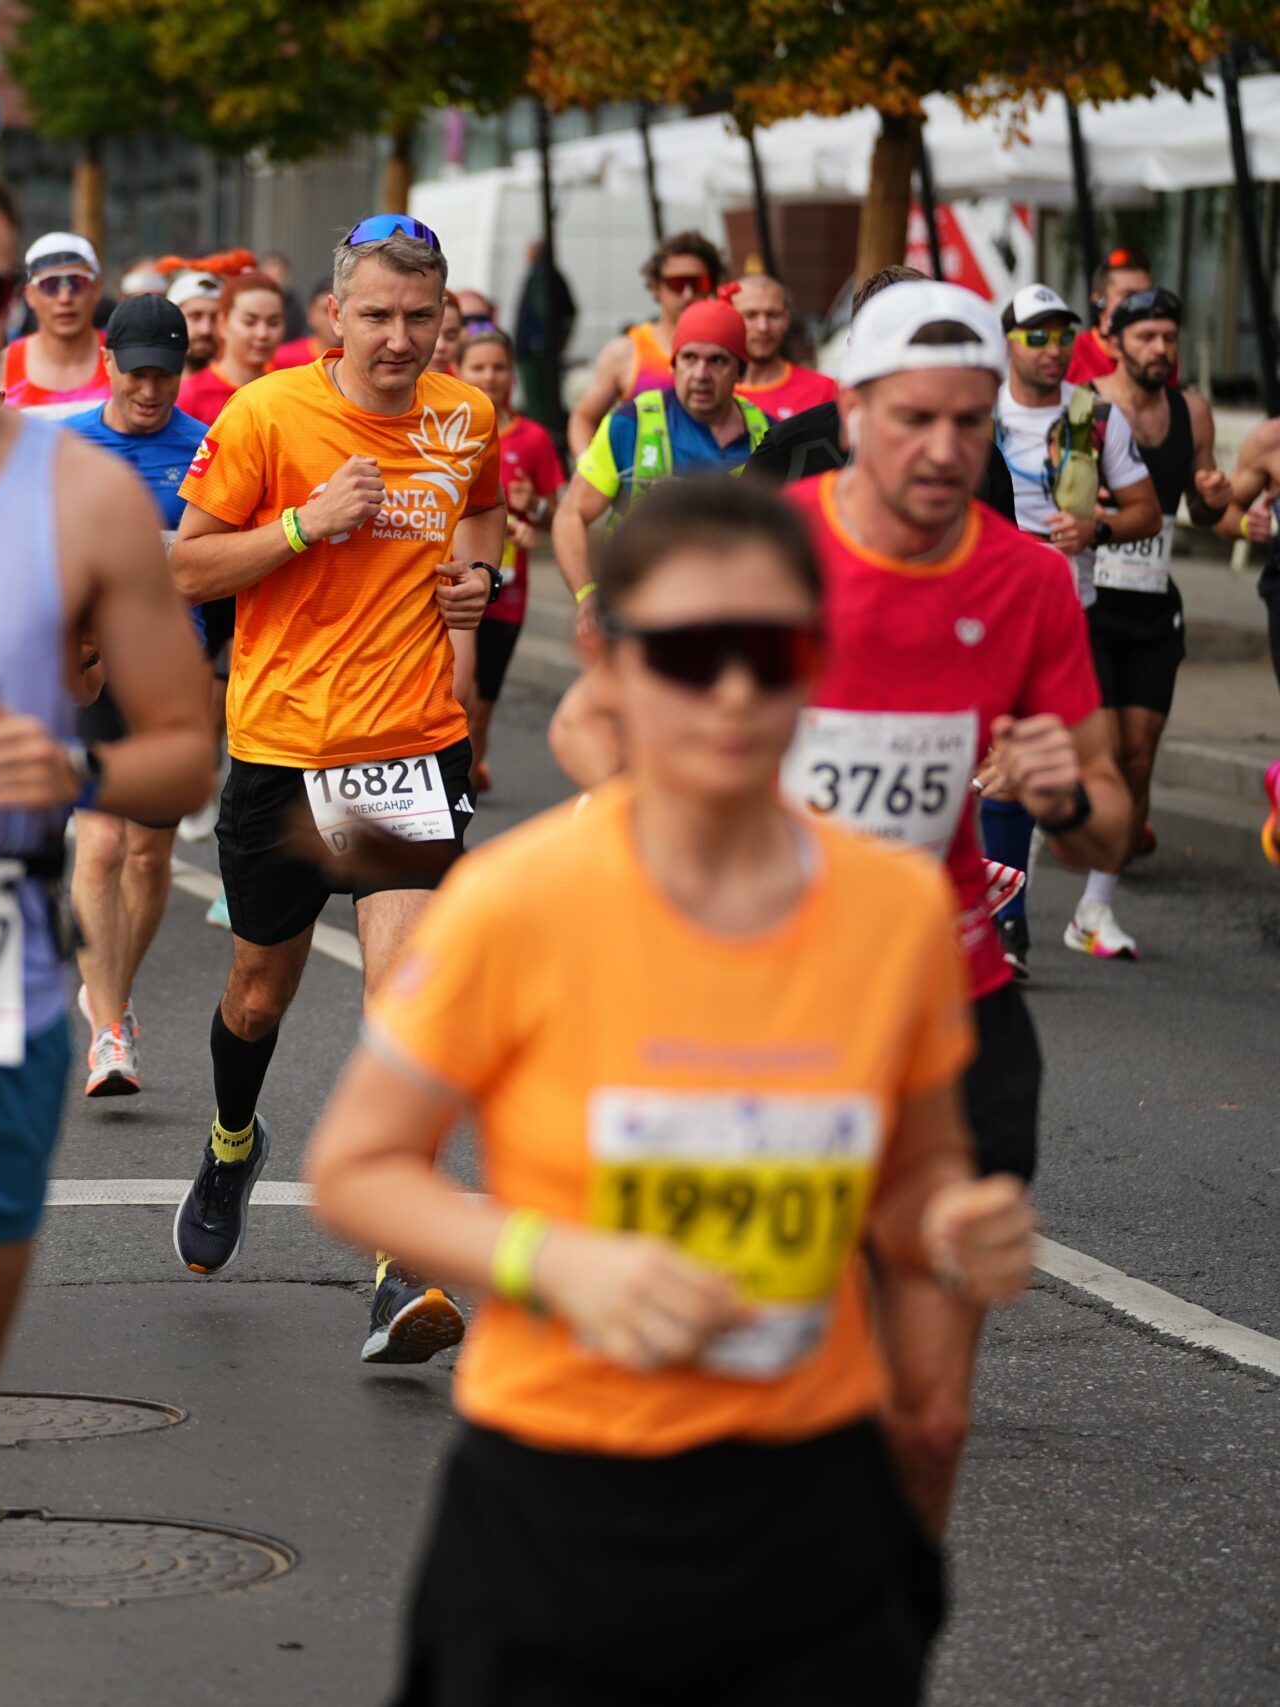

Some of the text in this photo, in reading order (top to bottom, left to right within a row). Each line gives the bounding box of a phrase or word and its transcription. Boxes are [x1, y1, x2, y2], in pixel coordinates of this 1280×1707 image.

[371, 528, 445, 541] MARATHON
[374, 509, 447, 529] SOCHI
[312, 758, 433, 804] 16821
[807, 762, 949, 816] 3765
[614, 1170, 855, 1257] 19901
